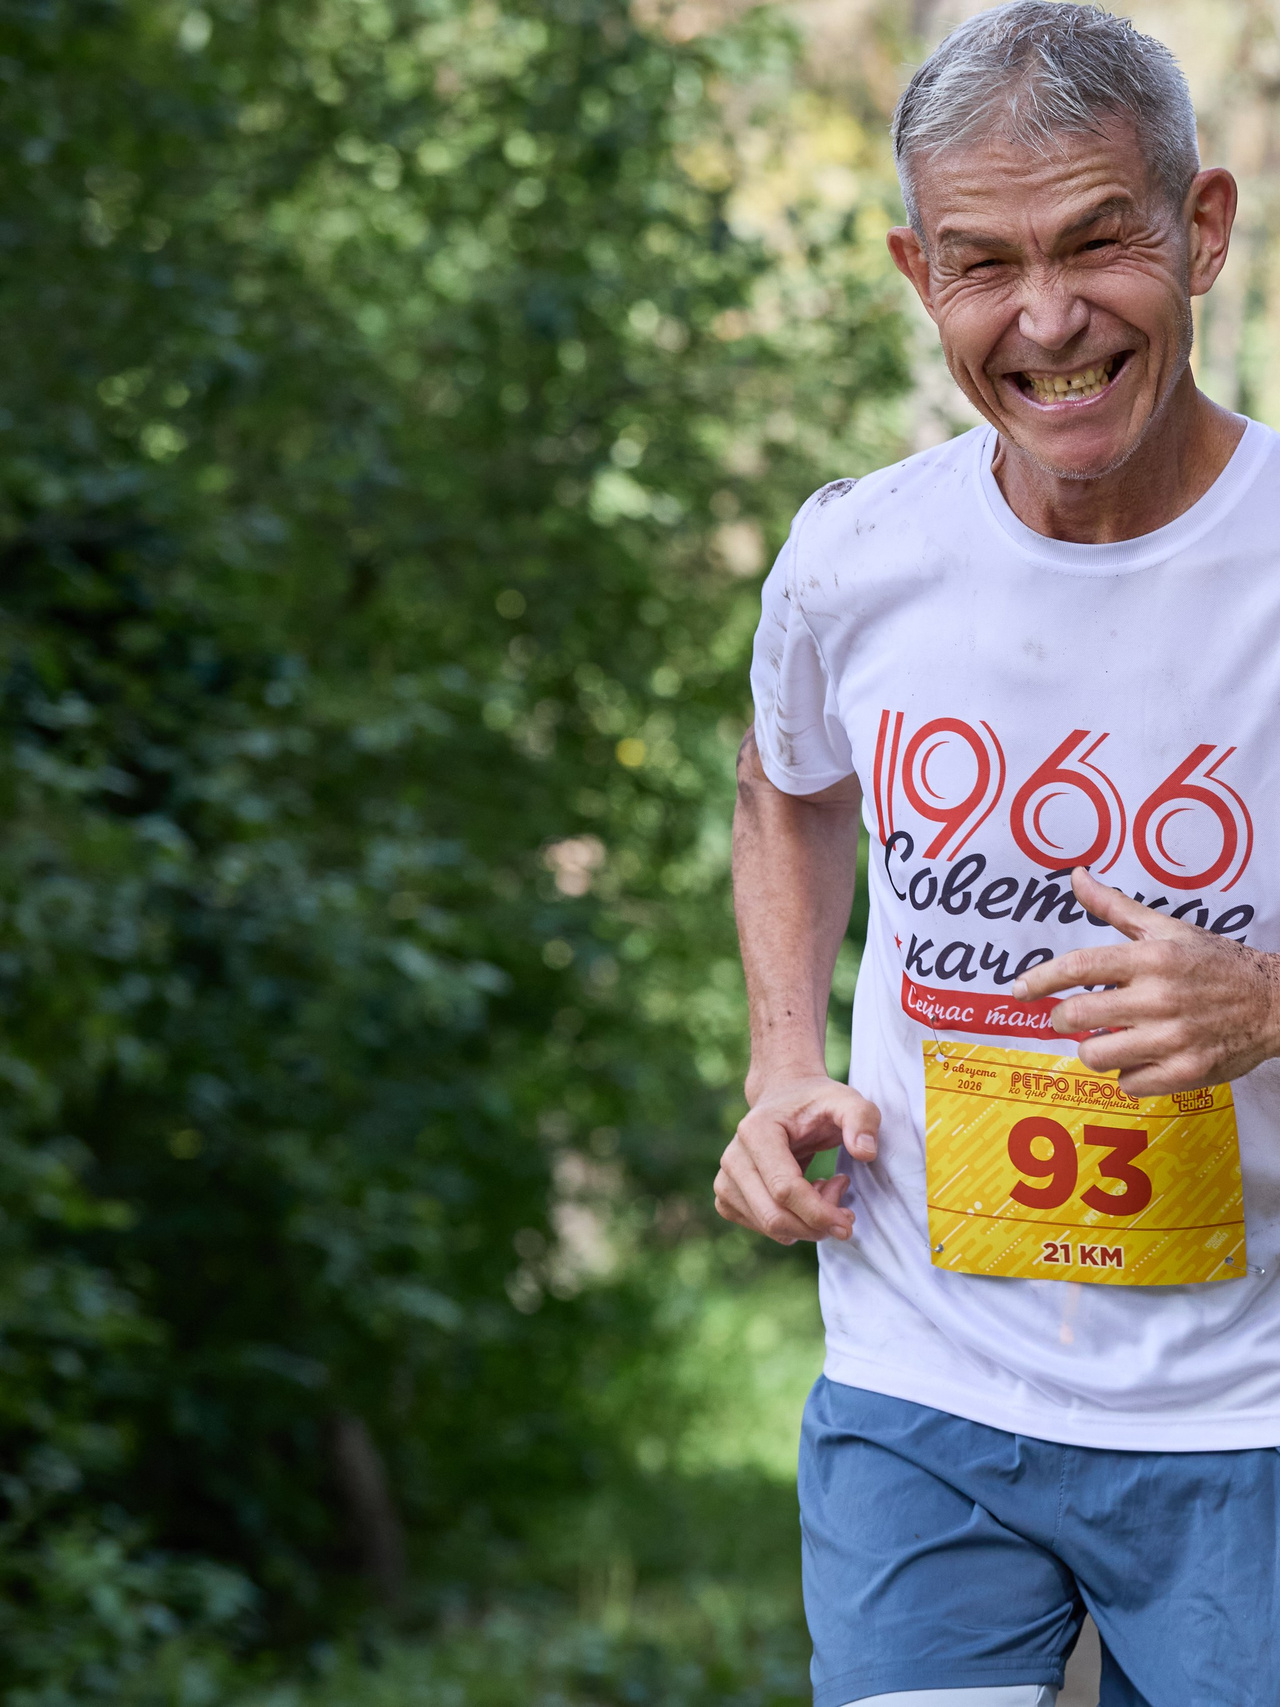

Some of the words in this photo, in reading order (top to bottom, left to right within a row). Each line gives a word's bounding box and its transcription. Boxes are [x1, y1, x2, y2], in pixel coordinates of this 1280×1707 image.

[873, 709, 1254, 893] 1966
[905, 932, 1118, 991] каче
[907, 984, 975, 1023] Сейчас
[985, 1004, 1054, 1030] таки
[942, 1061, 950, 1071] 9
[952, 1063, 998, 1079] августа
[957, 1078, 982, 1092] 2026
[1010, 1071, 1070, 1094] РЕТРО
[1008, 1086, 1021, 1096] ко
[1025, 1088, 1047, 1099] дню
[1051, 1091, 1141, 1111] физкультурника
[1172, 1087, 1208, 1103] СПОРТ
[1180, 1096, 1212, 1111] СОЮЗ
[1007, 1116, 1153, 1217] 93
[1042, 1242, 1072, 1264] 21
